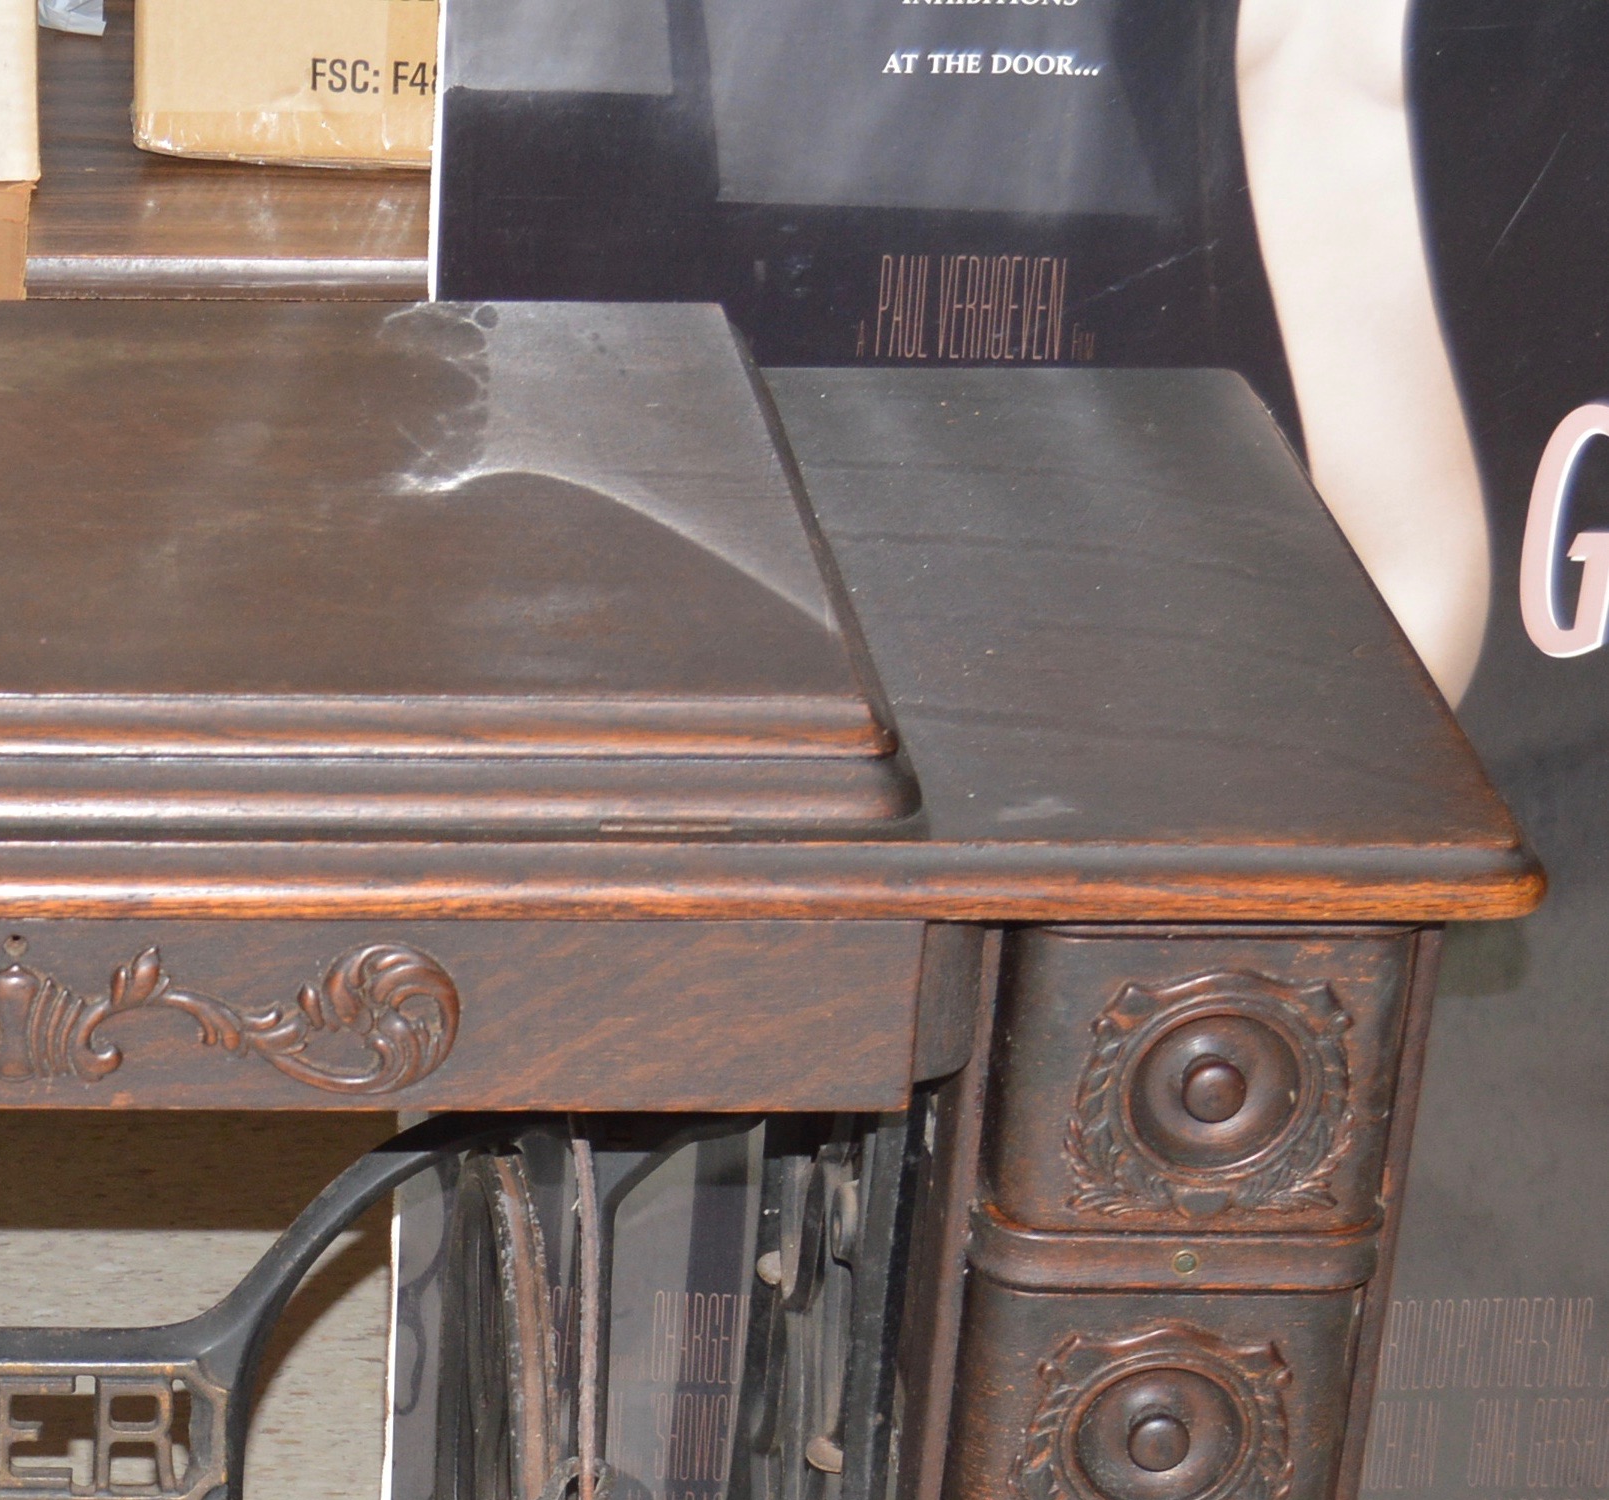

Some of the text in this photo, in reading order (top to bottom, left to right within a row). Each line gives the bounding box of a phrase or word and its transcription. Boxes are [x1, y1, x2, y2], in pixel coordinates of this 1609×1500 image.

[310, 57, 380, 94] FSC:
[882, 53, 1100, 76] AT THE DOOR...
[875, 254, 929, 358] PAUL
[938, 255, 1067, 360] VERHOEVEN
[1453, 1298, 1555, 1388] PICTURES
[1467, 1398, 1519, 1487] GINA
[1527, 1398, 1609, 1487] GERSHO
